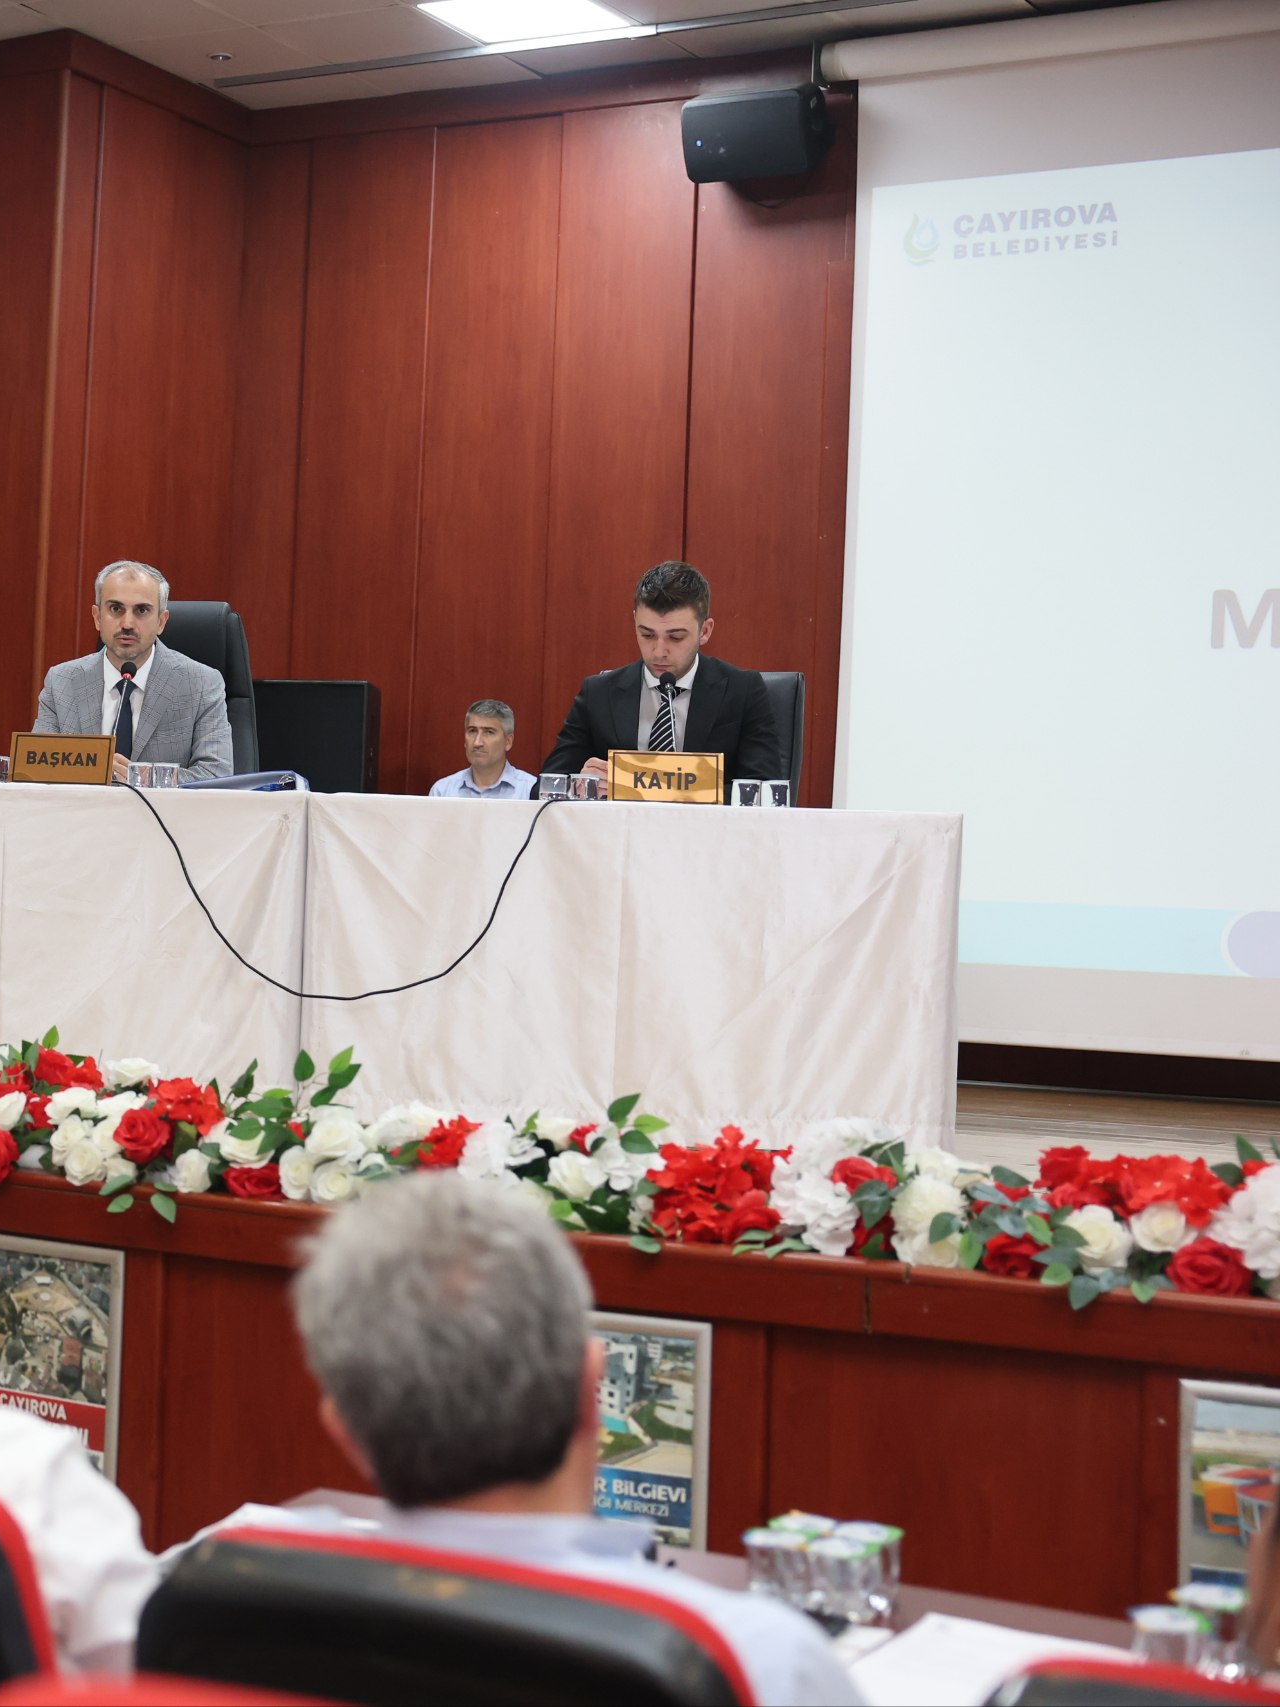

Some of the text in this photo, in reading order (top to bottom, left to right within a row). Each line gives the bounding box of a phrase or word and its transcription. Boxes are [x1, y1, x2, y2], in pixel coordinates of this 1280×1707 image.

[952, 201, 1118, 239] ÇAYIROVA
[952, 230, 1118, 260] BELEDİYESİ
[25, 750, 98, 768] BAŞKAN
[633, 767, 697, 791] KATİP
[612, 1478, 687, 1504] BİLGİEVİ
[614, 1497, 670, 1518] MERKEZİ
